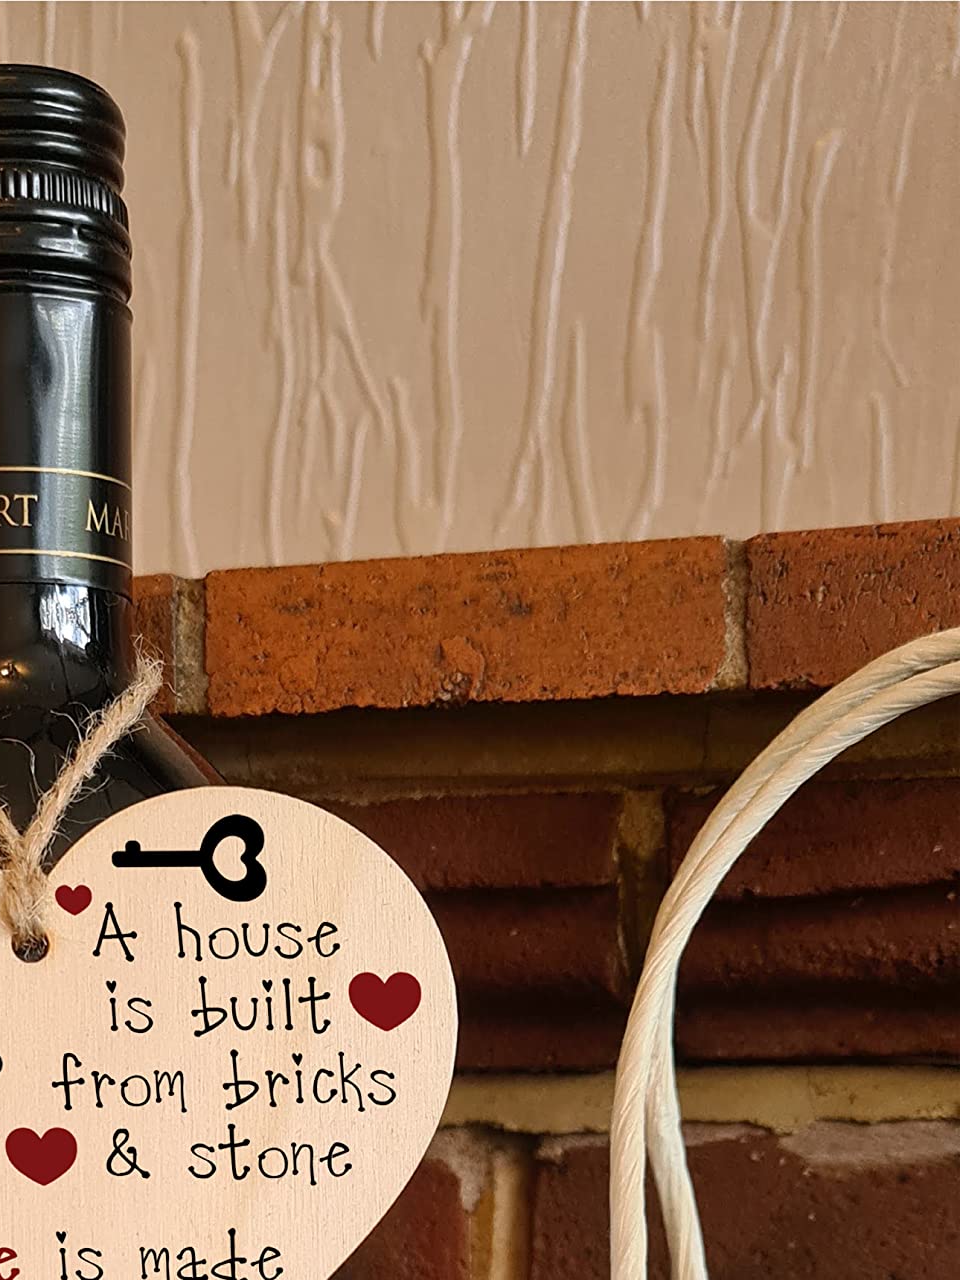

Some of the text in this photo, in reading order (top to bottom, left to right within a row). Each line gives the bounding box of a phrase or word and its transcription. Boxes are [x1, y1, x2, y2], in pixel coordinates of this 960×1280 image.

[92, 901, 341, 962] A house
[106, 976, 331, 1037] is built
[52, 1049, 397, 1113] from bricks
[105, 1123, 353, 1186] & stone
